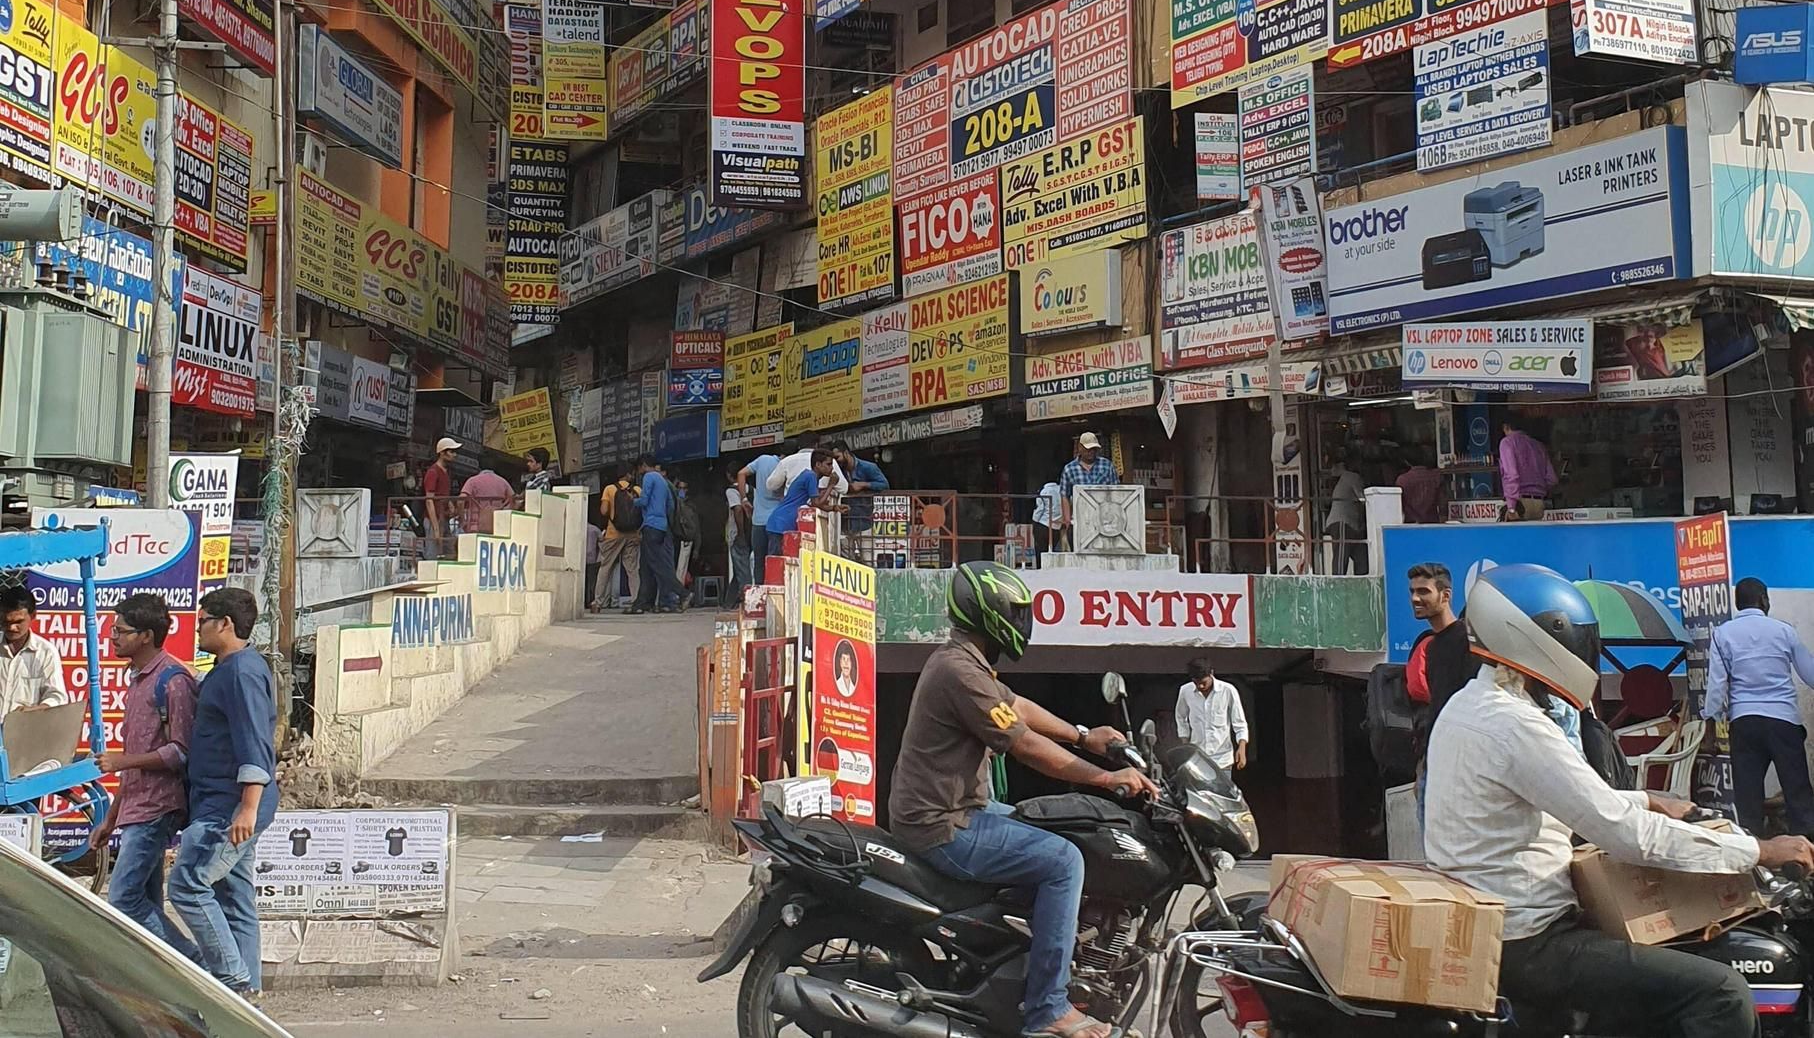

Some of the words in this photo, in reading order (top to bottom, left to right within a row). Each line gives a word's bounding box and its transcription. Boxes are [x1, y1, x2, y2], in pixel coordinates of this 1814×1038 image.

[562, 27, 600, 41] talend
[1594, 9, 1643, 40] 307A
[951, 9, 1056, 80] AUTOCAD
[1363, 30, 1406, 60] 208A
[1418, 30, 1504, 69] LapTechie
[340, 59, 373, 104] GLOBAL
[969, 46, 1052, 100] CISTOTECH
[1061, 47, 1128, 85] UNIGRAPHICS
[1424, 80, 1450, 97] USED
[1453, 67, 1499, 88] LAPTOPS
[1502, 56, 1537, 74] SALES
[964, 91, 1042, 155] 208-A
[1061, 100, 1123, 134] HYPERMESH
[511, 147, 566, 162] ETABS
[722, 155, 799, 170] Visualpath
[829, 132, 878, 173] MS-BI
[1244, 155, 1272, 172] SPOKEN
[1275, 145, 1310, 163] ENGLISH
[1558, 167, 1590, 185] LASER
[1593, 165, 1601, 176] &
[1604, 159, 1624, 174] INK
[1627, 148, 1656, 167] TANK
[302, 175, 344, 207] AUTOCAD
[1005, 208, 1030, 226] Adv.
[1034, 194, 1068, 217] Excel
[1071, 187, 1099, 204] With
[1103, 169, 1140, 195] V.B.A
[1603, 169, 1658, 194] PRINTERS
[903, 198, 970, 258] FICO
[1329, 206, 1409, 245] brother
[1345, 248, 1354, 258] at
[1357, 244, 1375, 258] your
[1377, 238, 1396, 251] side
[911, 299, 943, 329] DATA
[946, 279, 1007, 319] SCIENCE
[182, 303, 255, 363] LINUX
[1406, 329, 1421, 344] VSL
[1425, 328, 1462, 343] LAPTOP
[1466, 328, 1493, 343] ZONE
[1496, 328, 1527, 343] SALES
[1530, 328, 1538, 341] &
[1541, 327, 1584, 342] SERVICE
[178, 348, 252, 376] ADMINISTRATION
[1032, 360, 1051, 379] Adv.
[1055, 351, 1092, 375] EXCEL
[1095, 346, 1116, 366] with
[1118, 338, 1144, 362] VBA
[1431, 355, 1478, 370] Lenovo
[1508, 355, 1554, 371] acer
[185, 470, 228, 493] GANA
[1449, 504, 1463, 520] SRI
[1465, 503, 1499, 520] GANESH
[479, 540, 528, 590] BLOCK
[820, 556, 870, 596] HANU
[393, 593, 473, 648] ANNAPURNA
[1033, 591, 1065, 627] O
[1080, 591, 1243, 630] ENTRY
